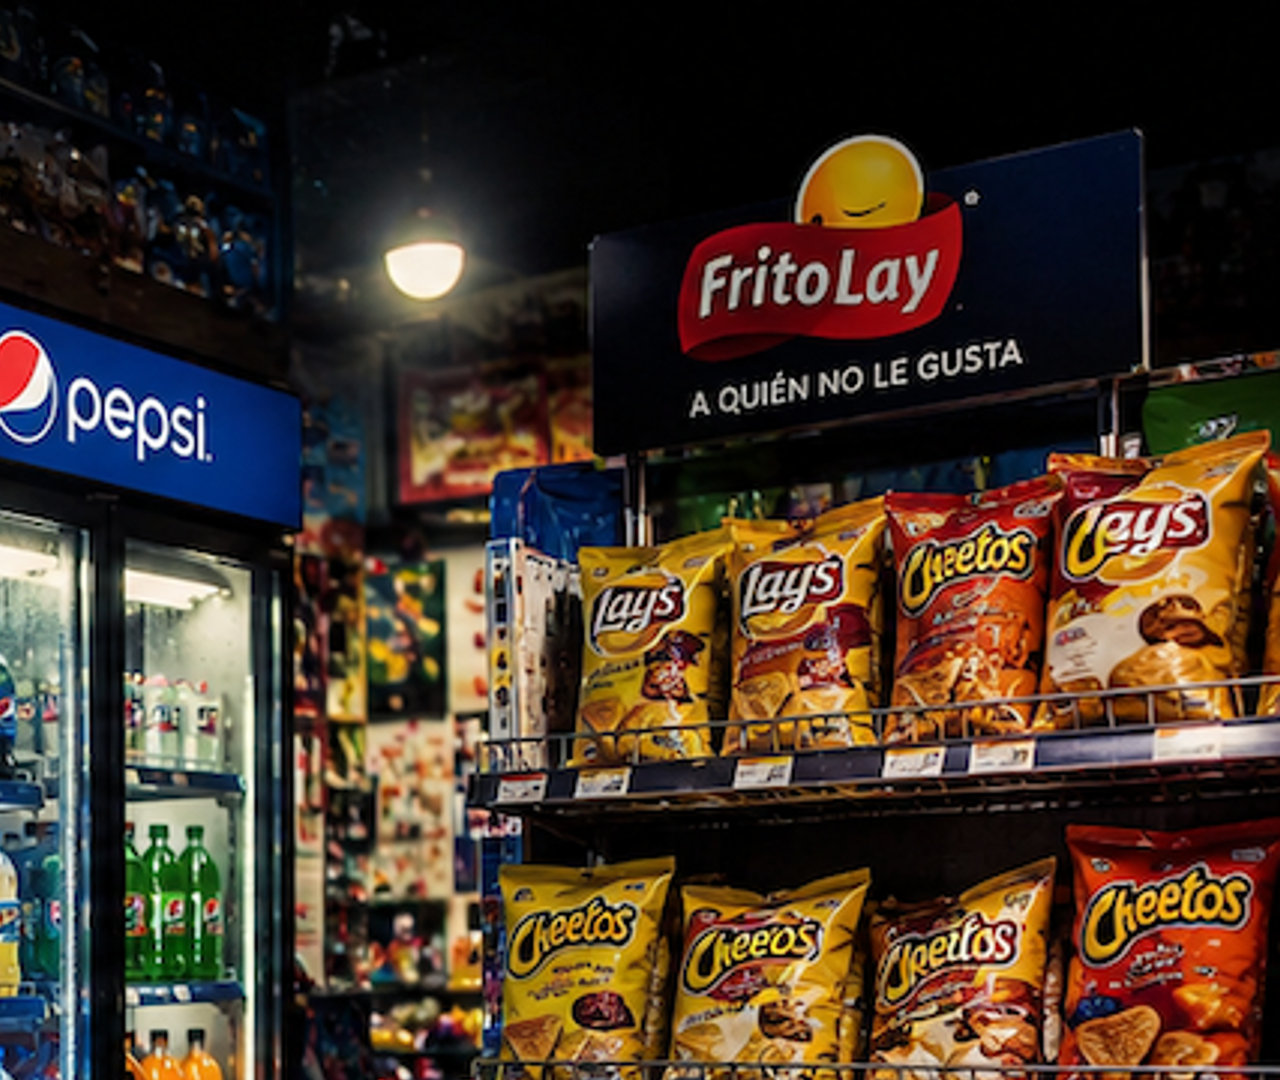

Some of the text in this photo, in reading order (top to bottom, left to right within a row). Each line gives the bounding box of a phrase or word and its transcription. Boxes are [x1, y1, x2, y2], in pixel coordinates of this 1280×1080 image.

[66, 376, 207, 463] pepsi
[689, 338, 1024, 419] A QUIÉN NO LE GUSTA
[1084, 871, 1248, 961] Cheetos
